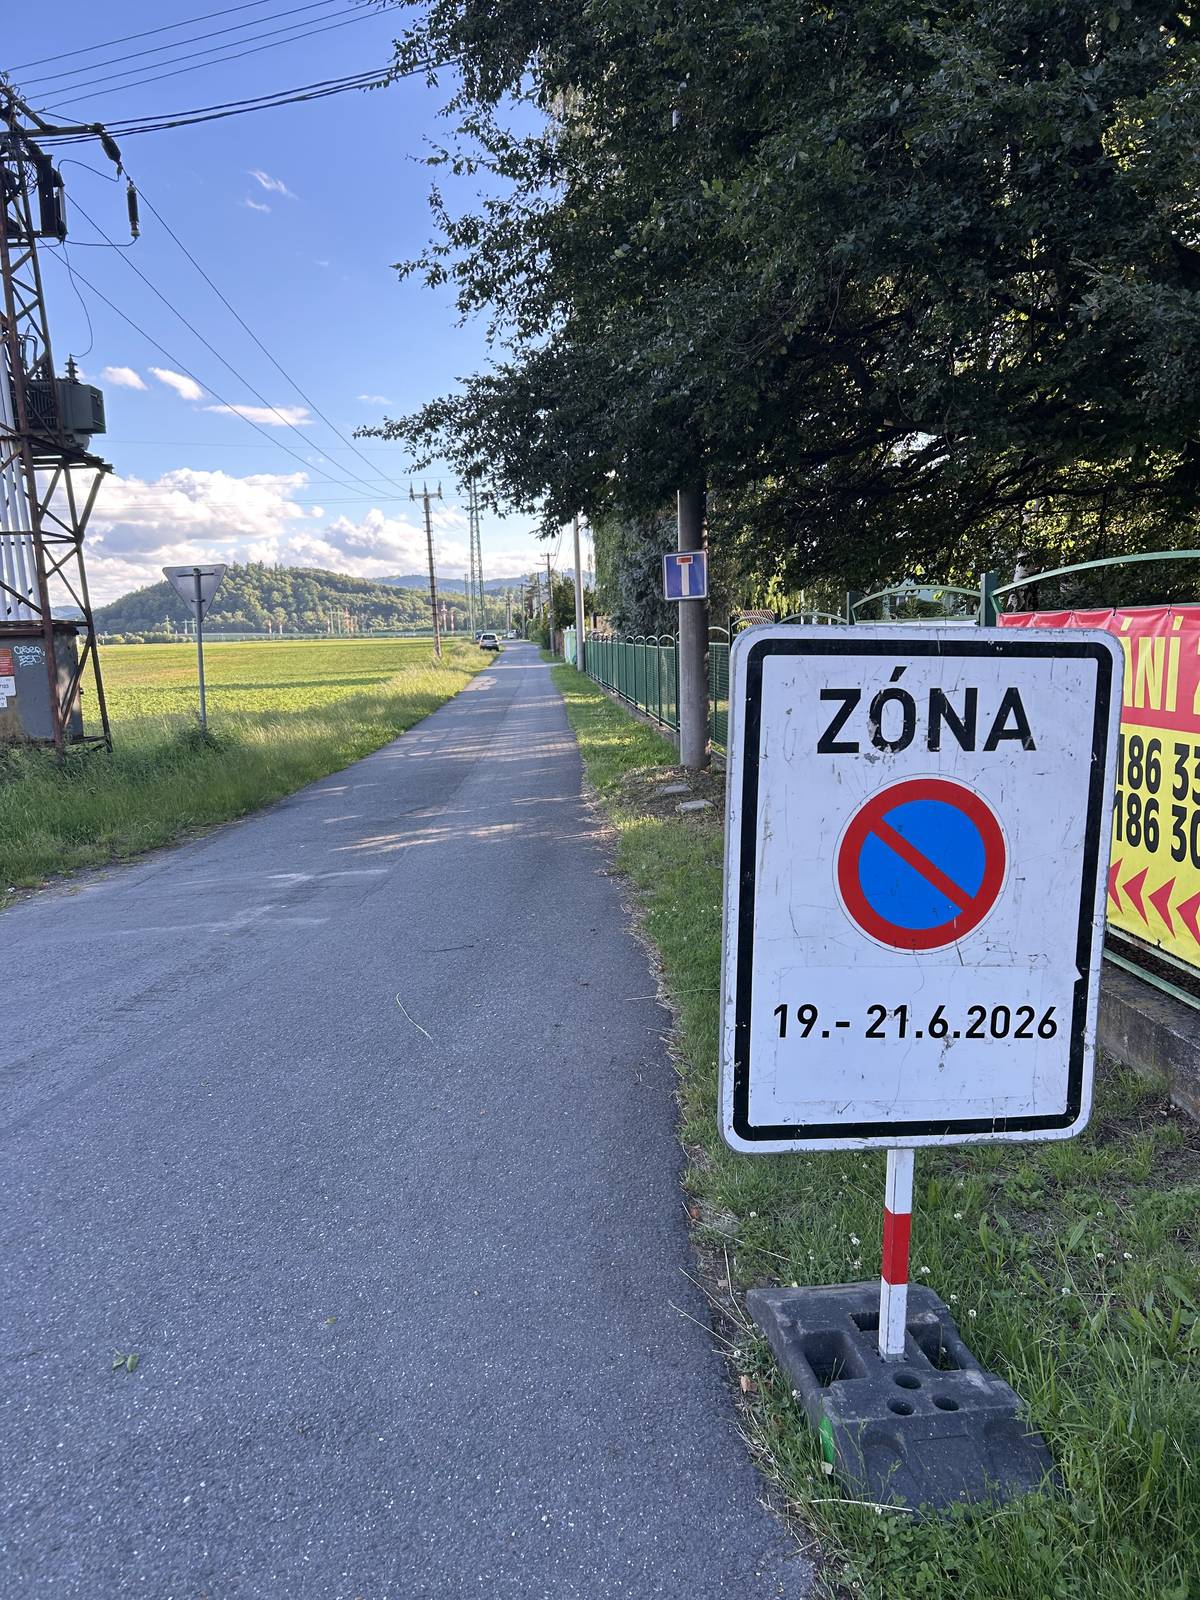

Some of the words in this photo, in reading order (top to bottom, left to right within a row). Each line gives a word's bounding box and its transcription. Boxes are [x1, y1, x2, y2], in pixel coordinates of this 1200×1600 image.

[817, 666, 1037, 754] ZÓNA
[1113, 790, 1160, 853] 186
[865, 1004, 1058, 1039] 21.6.2026
